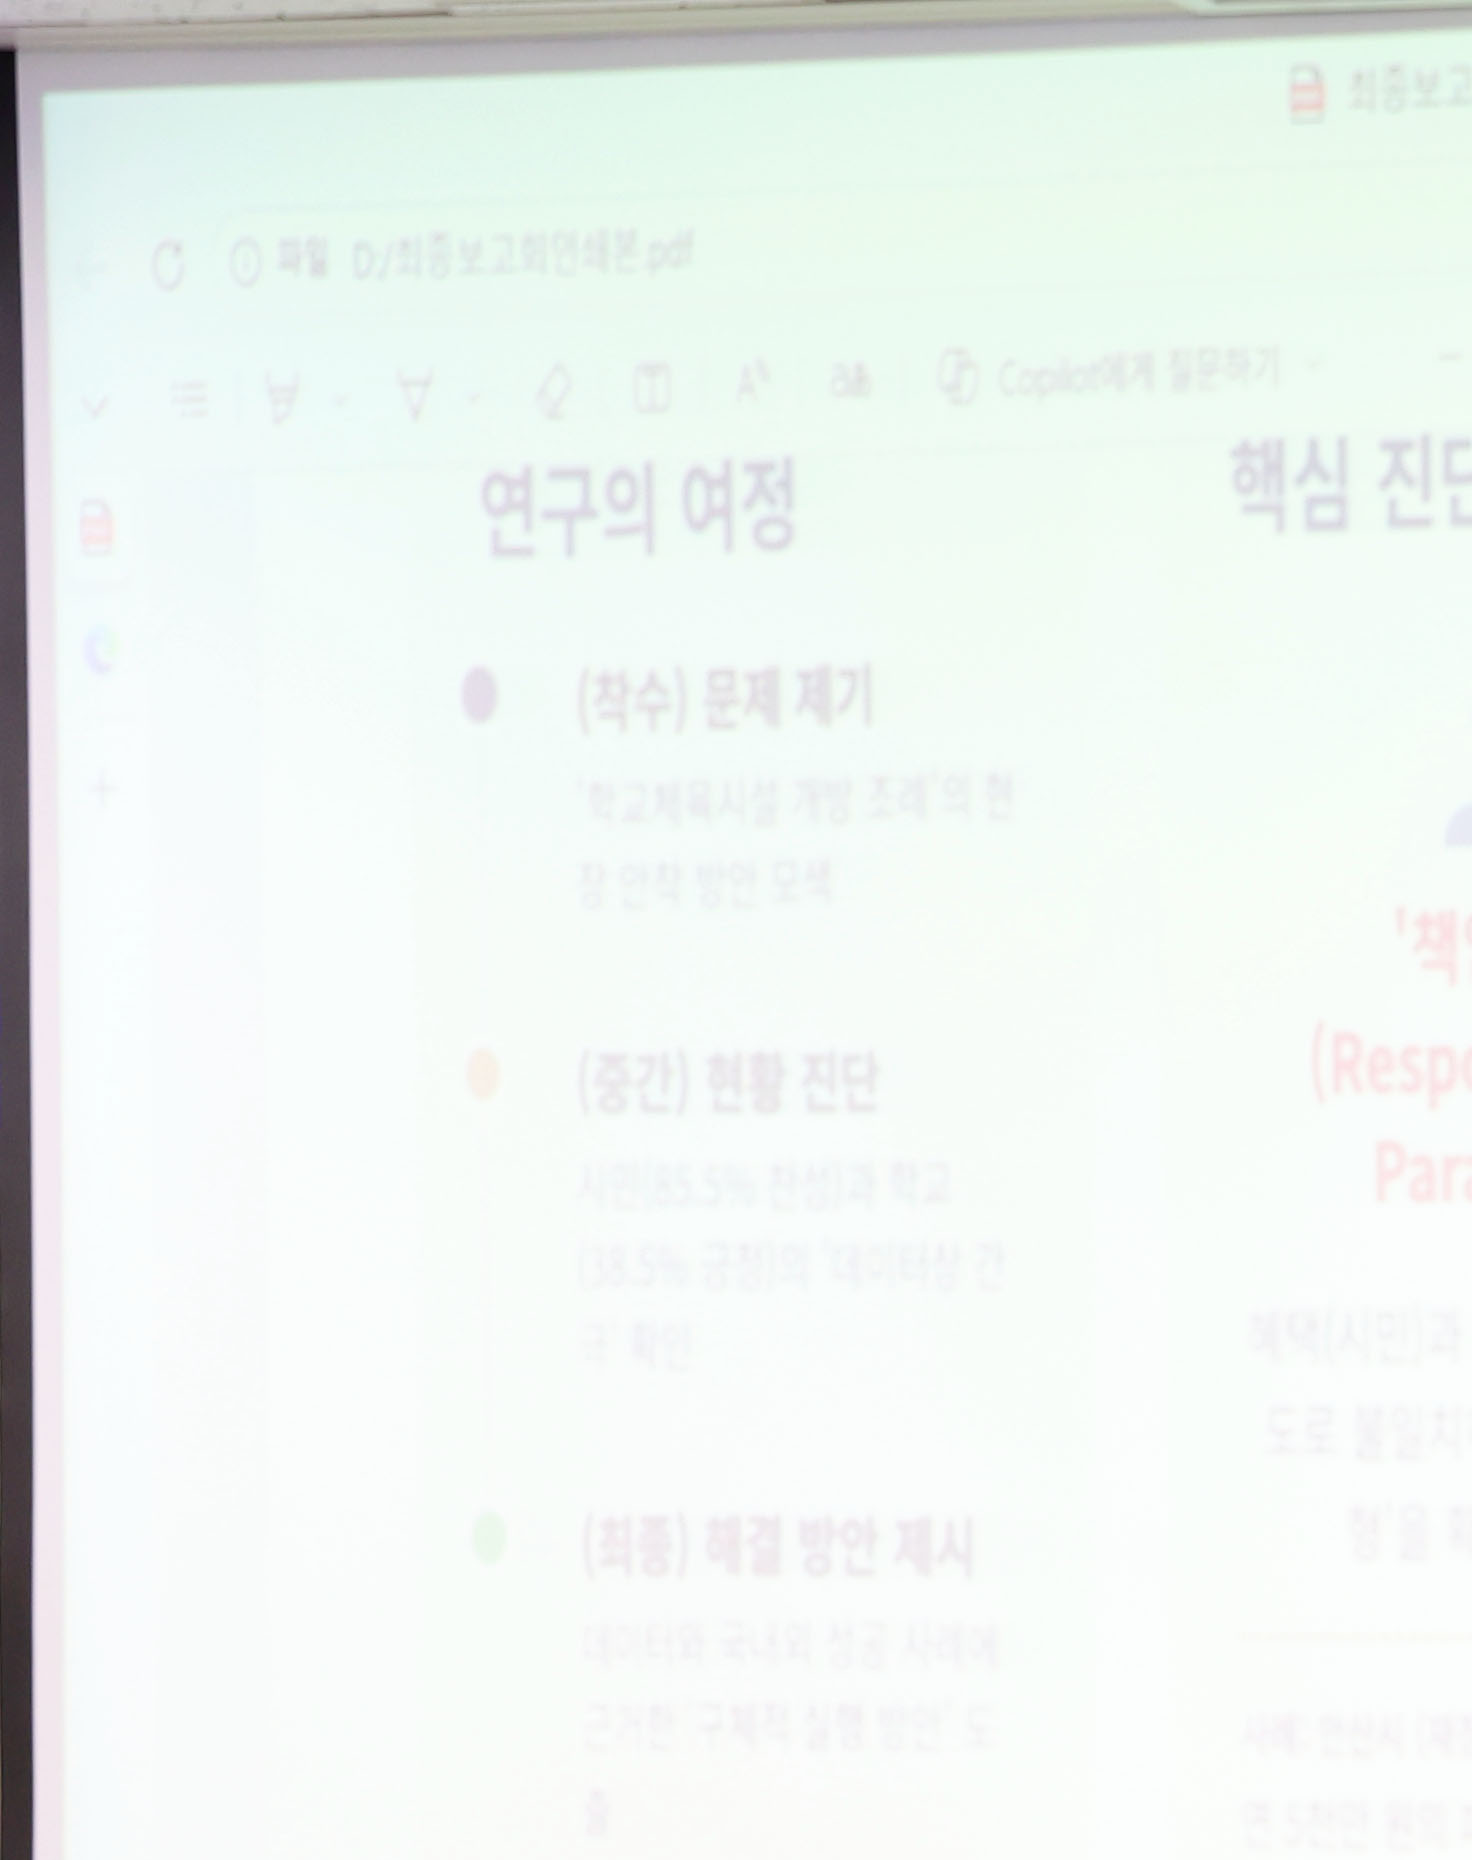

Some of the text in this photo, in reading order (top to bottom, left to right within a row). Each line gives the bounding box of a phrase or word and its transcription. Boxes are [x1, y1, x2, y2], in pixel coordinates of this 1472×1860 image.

[276, 233, 330, 280] 파일
[998, 345, 1283, 402] Copilot에게 질문하기
[480, 454, 797, 559] 연구의 여정
[1228, 434, 1351, 536] 핵심
[577, 659, 874, 736] (착수) 문제 제기
[577, 1046, 882, 1118] (중간) 현황 진단
[890, 1157, 952, 1206] 학교
[1262, 1401, 1339, 1458] 도로
[582, 1506, 976, 1583] (최종) 해결 방안 제시
